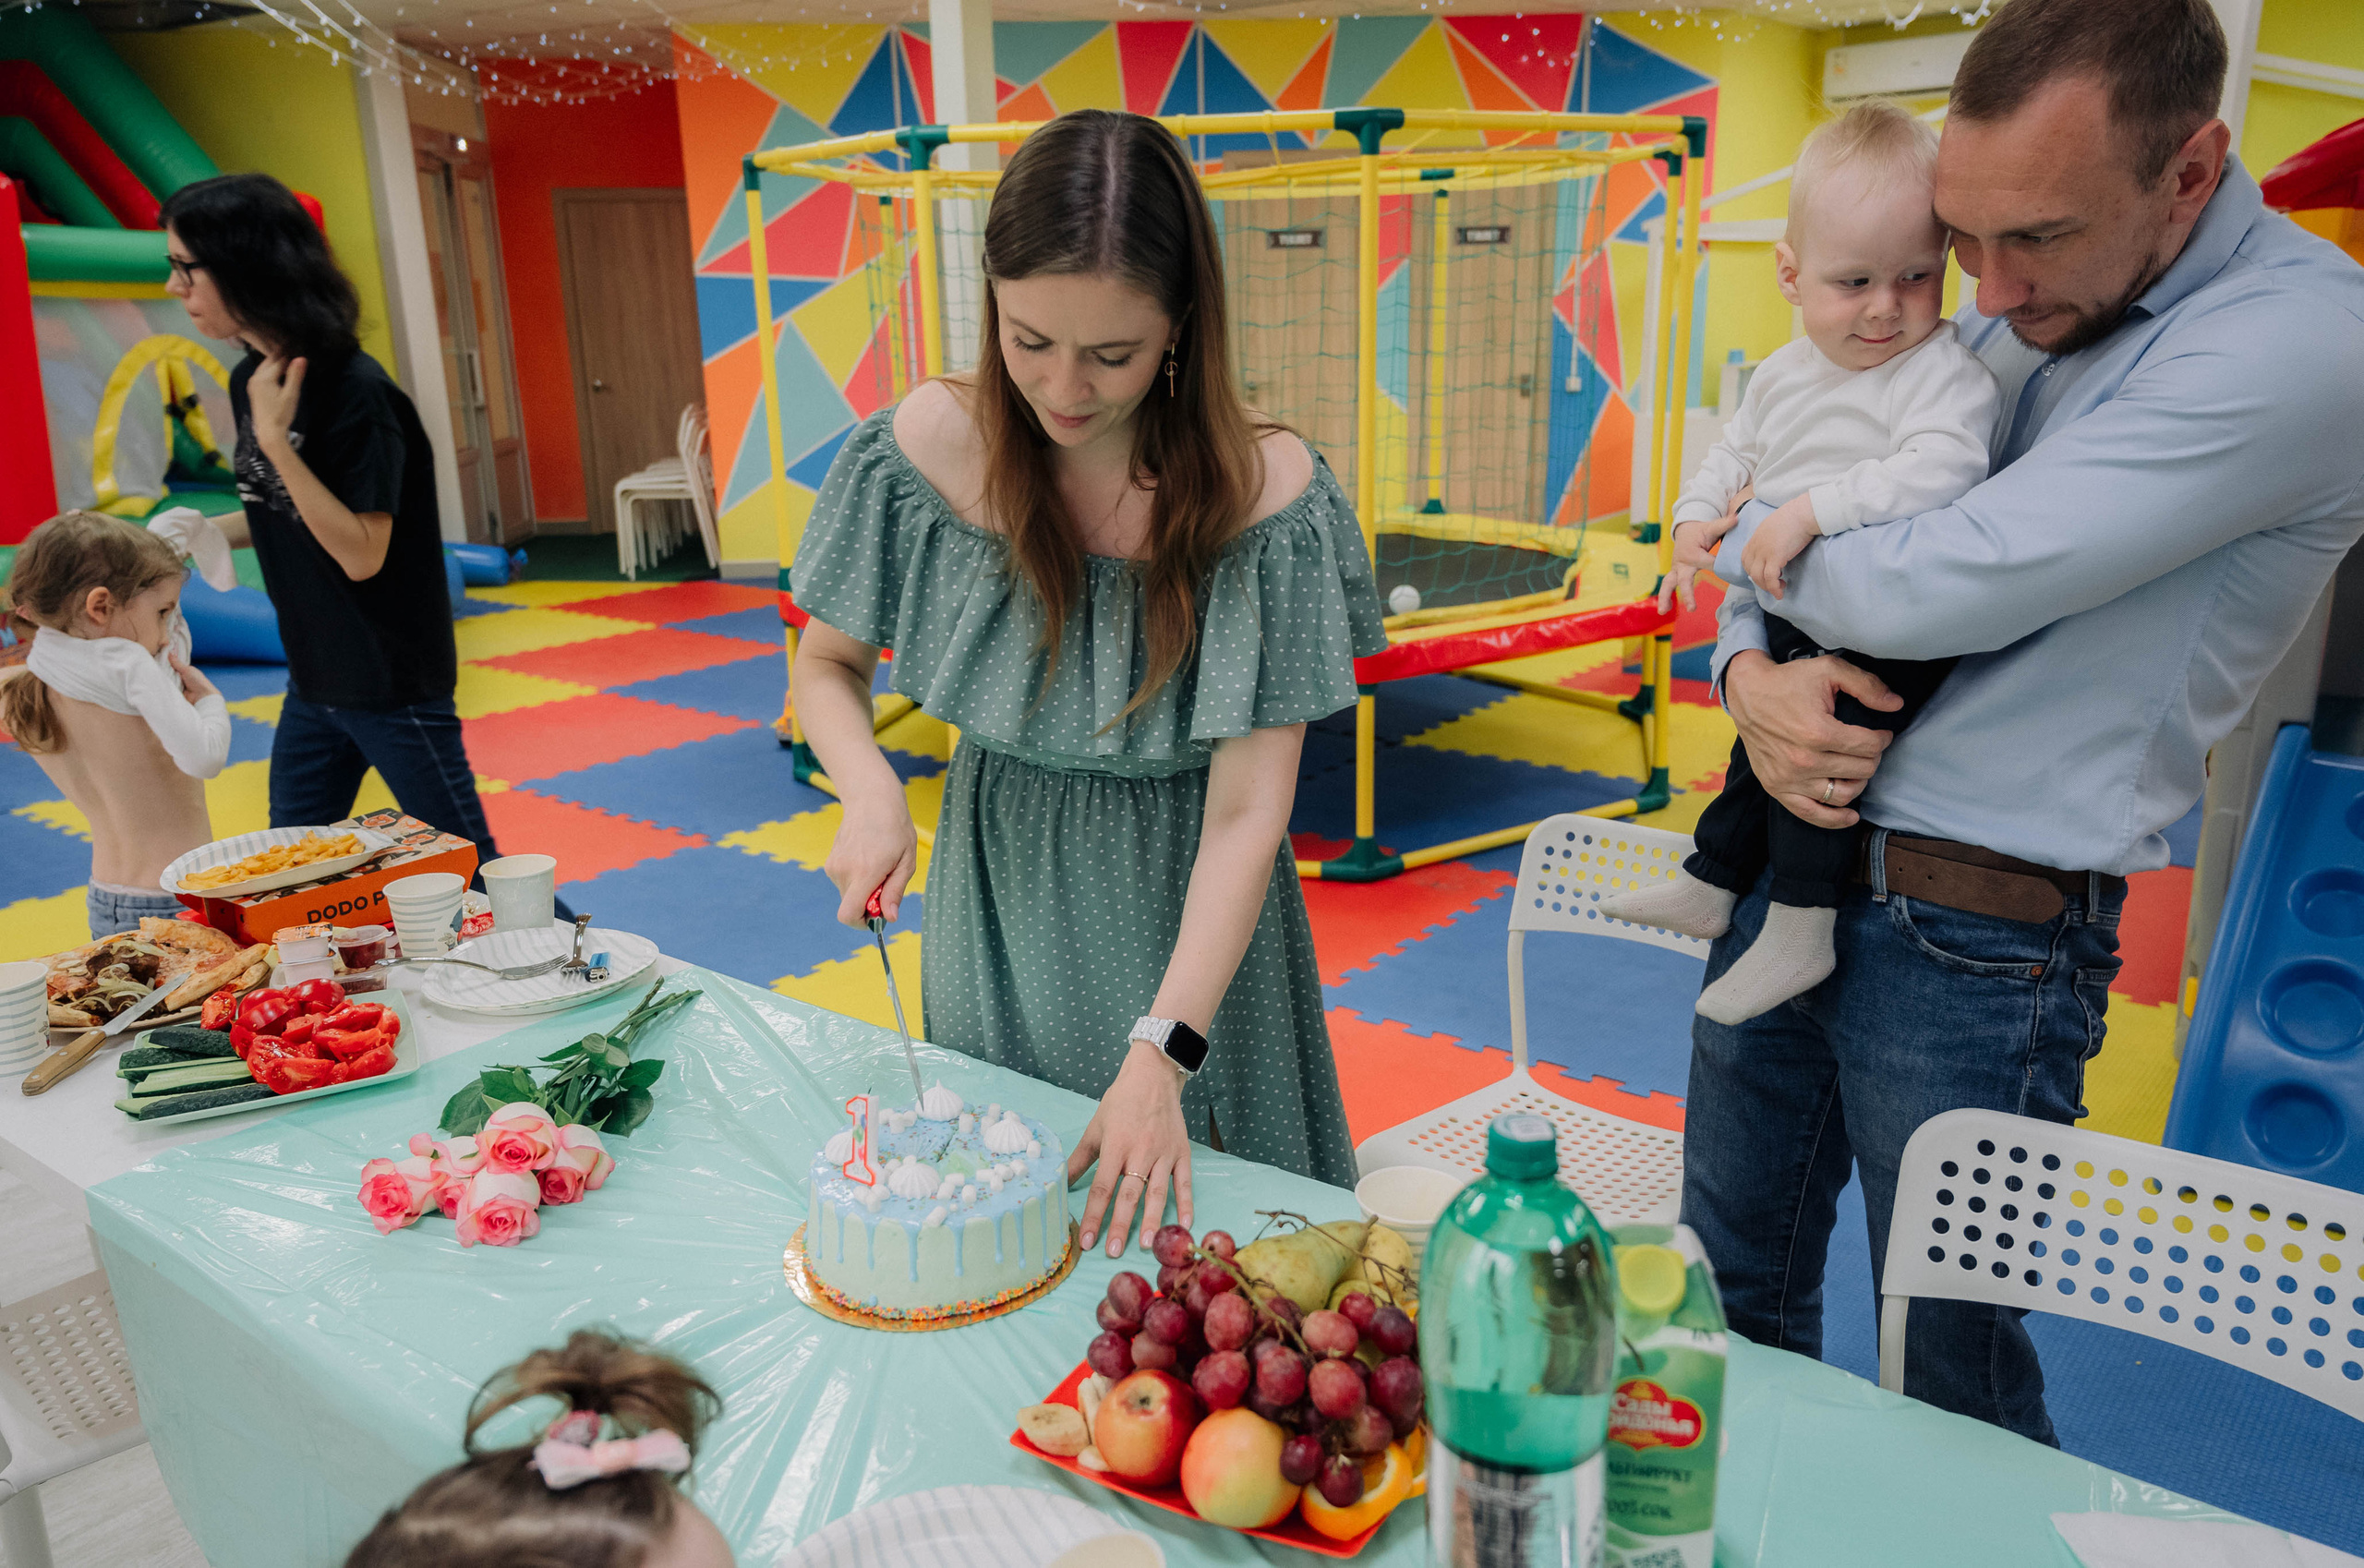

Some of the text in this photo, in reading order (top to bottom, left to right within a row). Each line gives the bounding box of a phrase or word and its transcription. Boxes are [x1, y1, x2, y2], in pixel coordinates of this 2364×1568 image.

[307, 890, 386, 924] DODO P
[842, 1095, 876, 1187] 1
